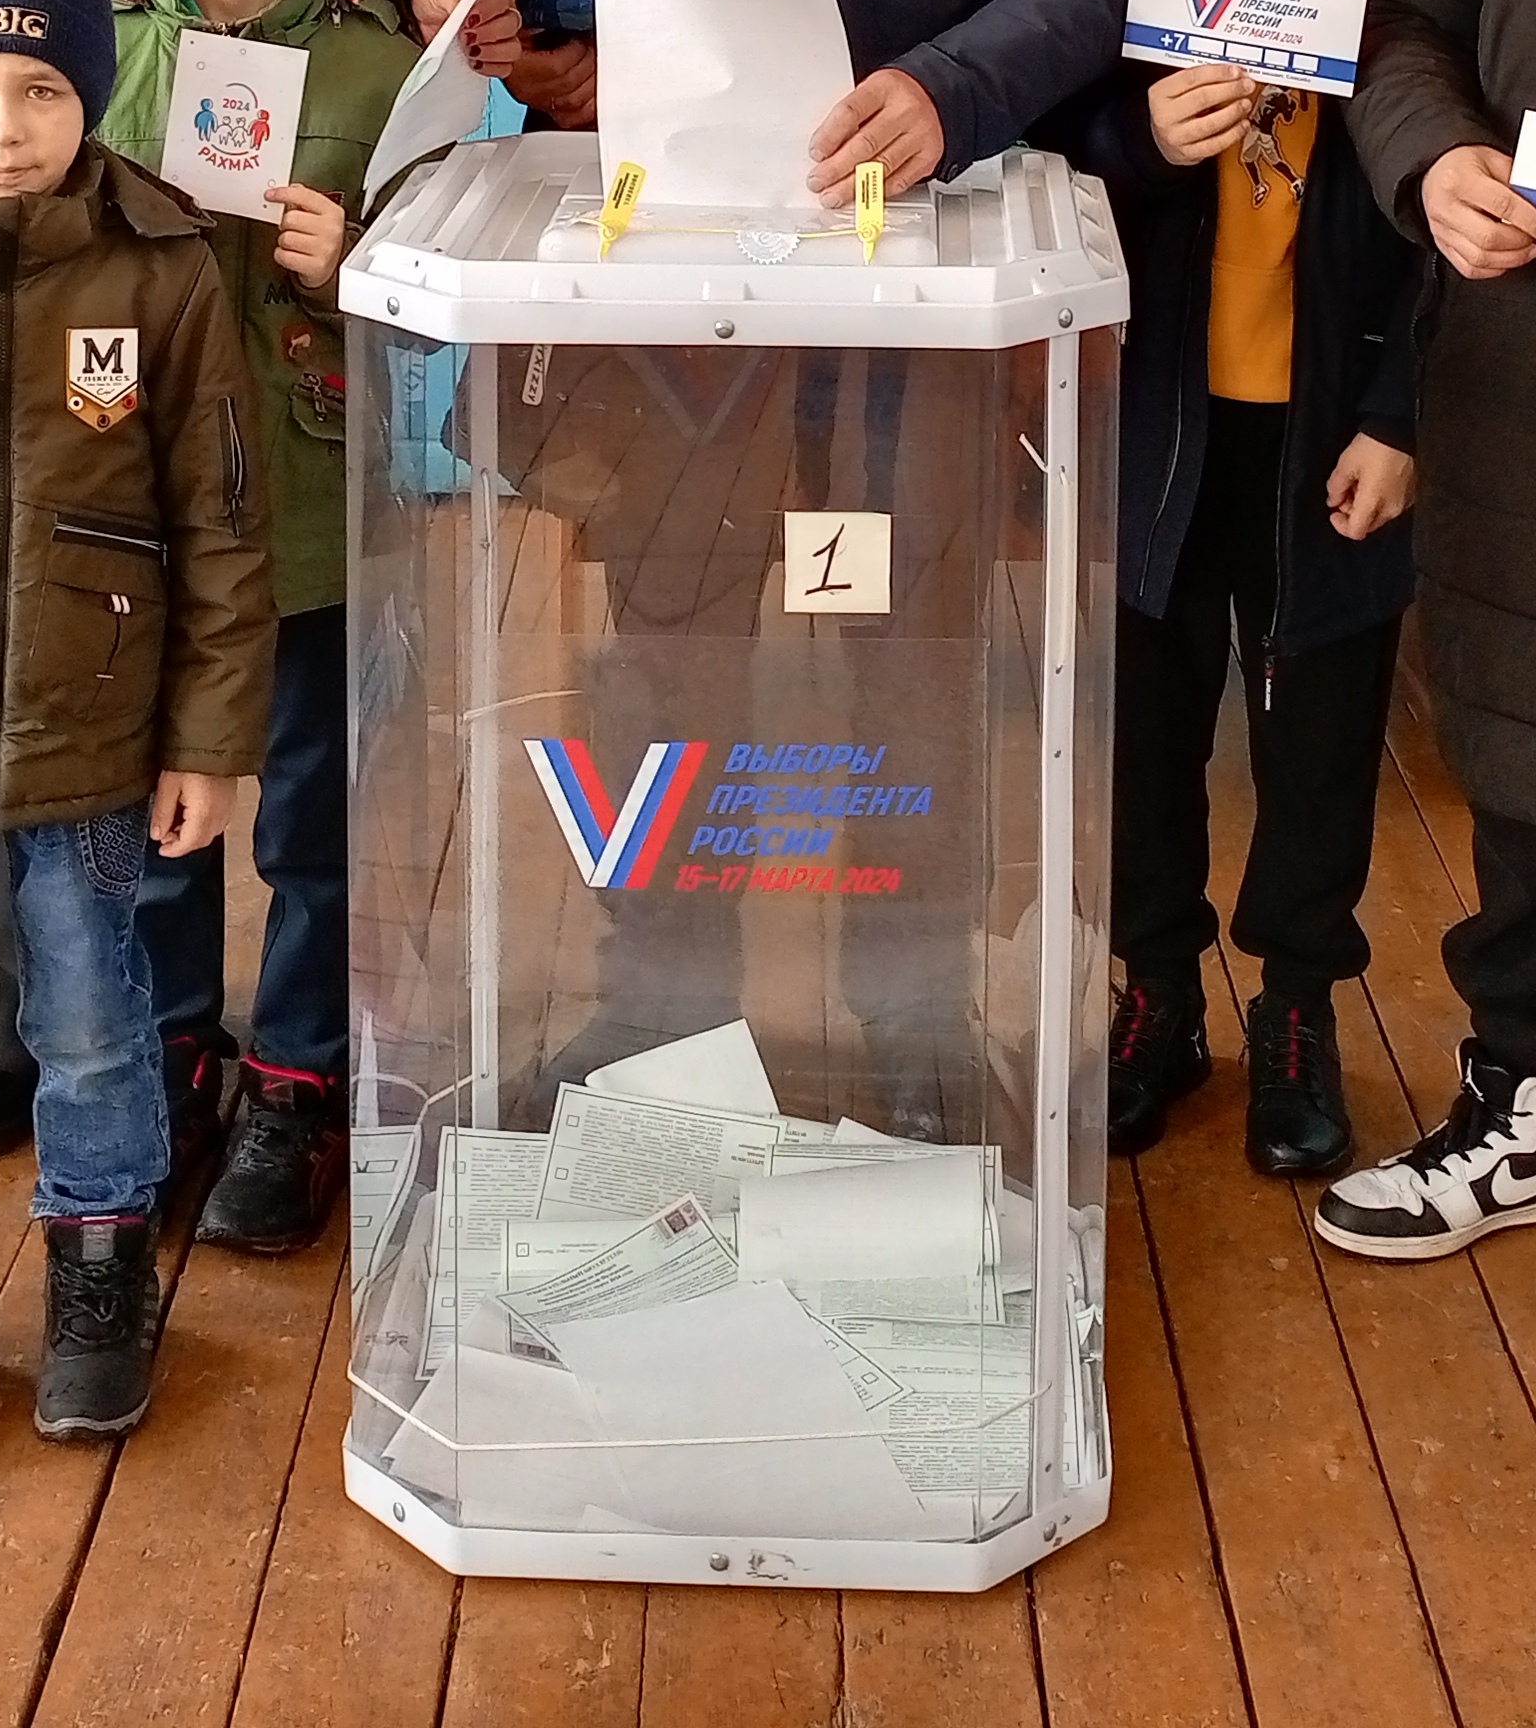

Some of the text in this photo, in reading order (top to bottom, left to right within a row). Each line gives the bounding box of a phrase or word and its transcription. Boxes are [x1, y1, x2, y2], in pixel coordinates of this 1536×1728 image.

[1230, 10, 1283, 28] РОССИИ
[1160, 32, 1186, 52] +7
[1250, 27, 1282, 42] МАРТА
[1280, 32, 1303, 45] 2024
[222, 98, 250, 112] 2024
[198, 146, 261, 172] РАХМАТ
[82, 337, 124, 374] M
[804, 521, 853, 596] 1
[723, 742, 887, 776] ВЫБОРЫ
[705, 784, 933, 818] ПРЕЗИДЕНТА
[687, 824, 834, 856] РОССИИ
[747, 866, 836, 893] МАРТА
[838, 867, 902, 894] 2024
